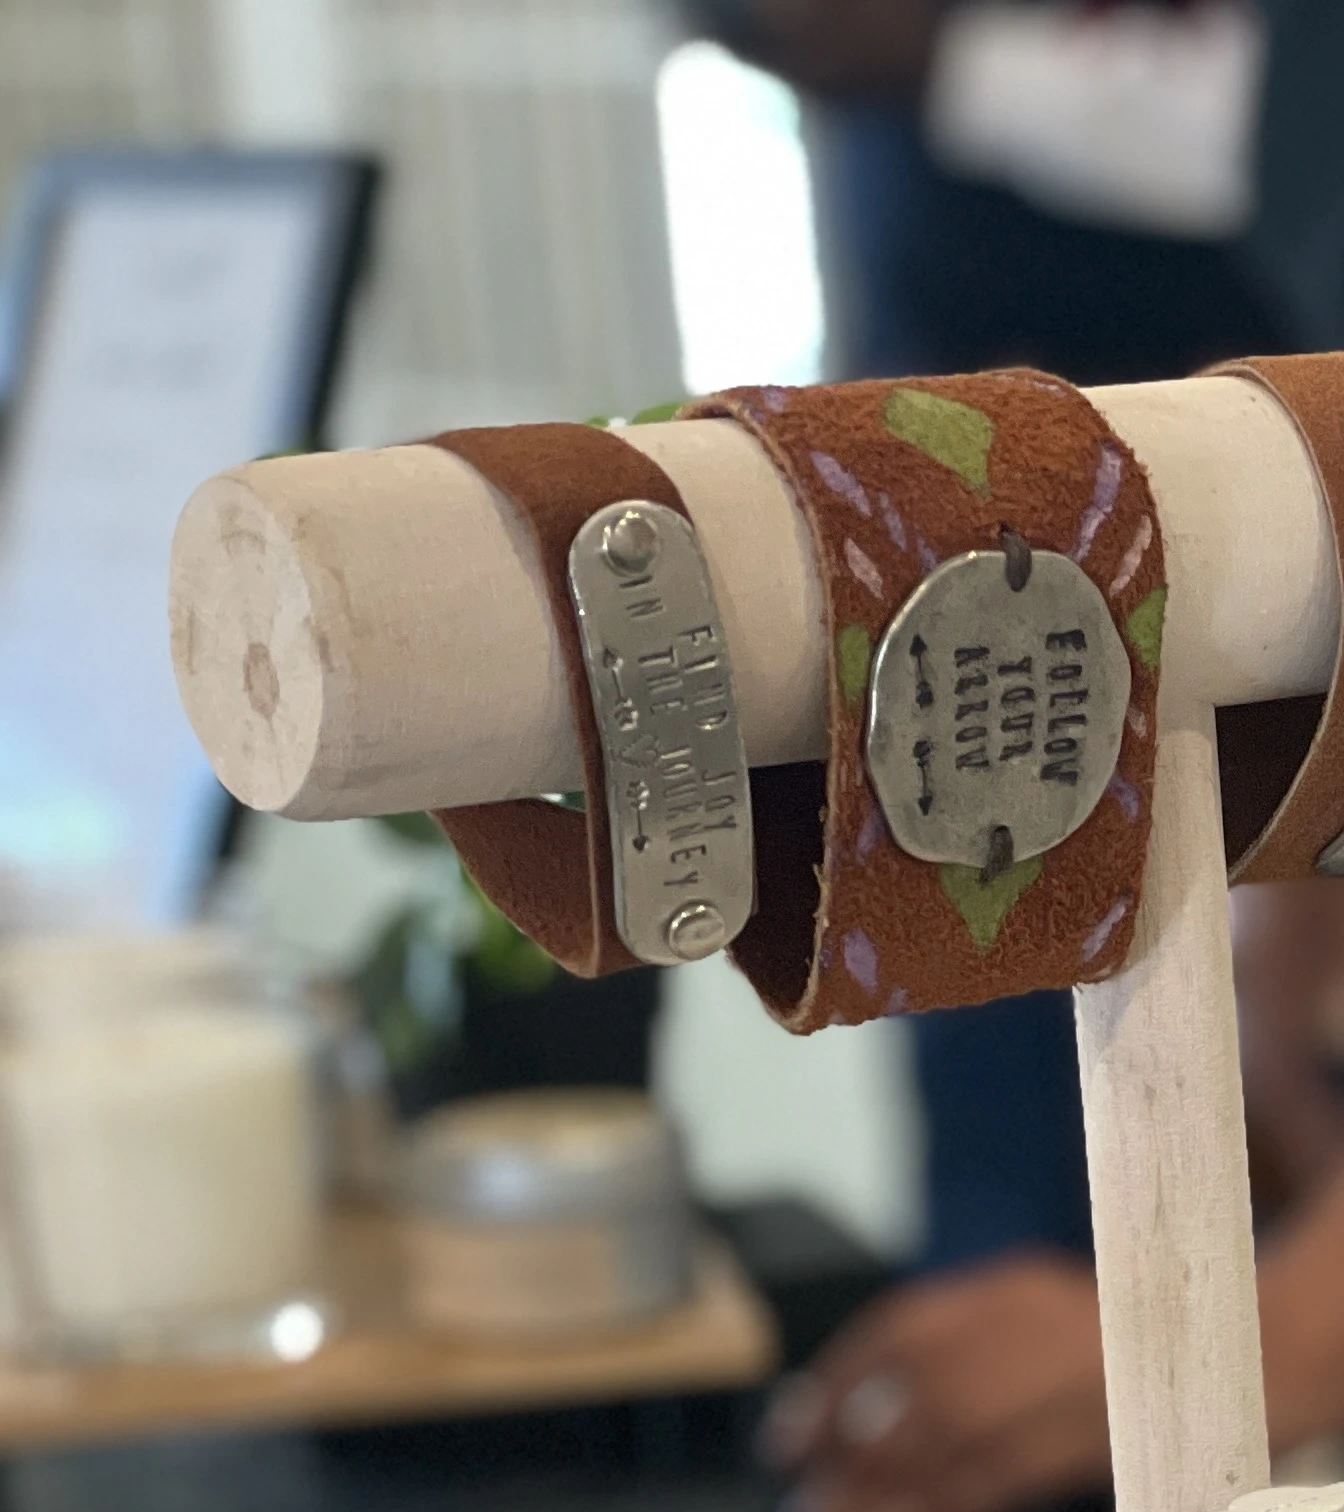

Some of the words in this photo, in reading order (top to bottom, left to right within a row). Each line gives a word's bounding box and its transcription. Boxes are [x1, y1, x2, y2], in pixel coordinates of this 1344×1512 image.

[619, 575, 664, 618] IN
[638, 647, 686, 715] THE
[677, 624, 729, 730] FIND
[998, 655, 1035, 761] YOUR
[660, 747, 707, 887] JOURNEY
[701, 770, 737, 830] JOY
